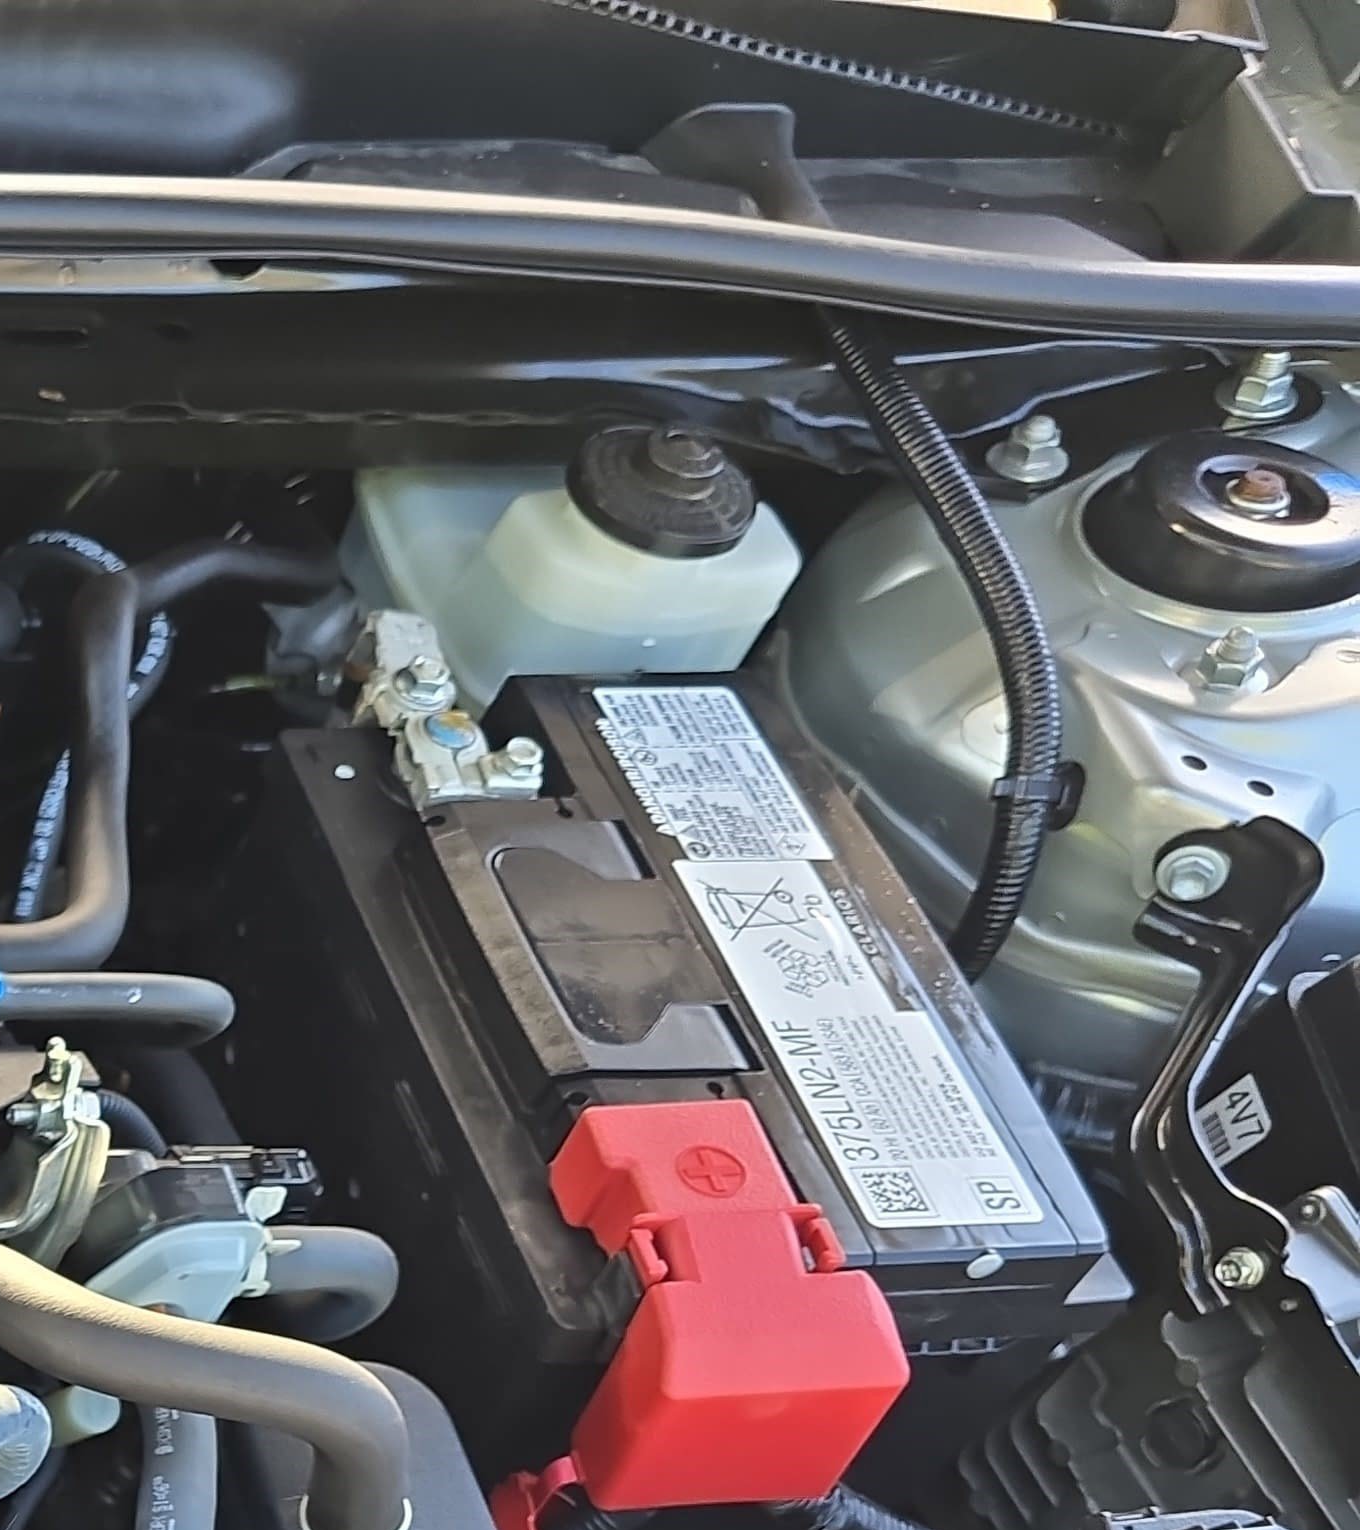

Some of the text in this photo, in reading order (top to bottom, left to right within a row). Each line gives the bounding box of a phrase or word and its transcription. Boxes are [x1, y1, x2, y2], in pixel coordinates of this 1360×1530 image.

[829, 886, 880, 956] CLARIOS
[771, 1020, 880, 1162] 375LN2-MF
[1225, 1091, 1265, 1140] 4V7
[976, 1180, 1022, 1210] SP
